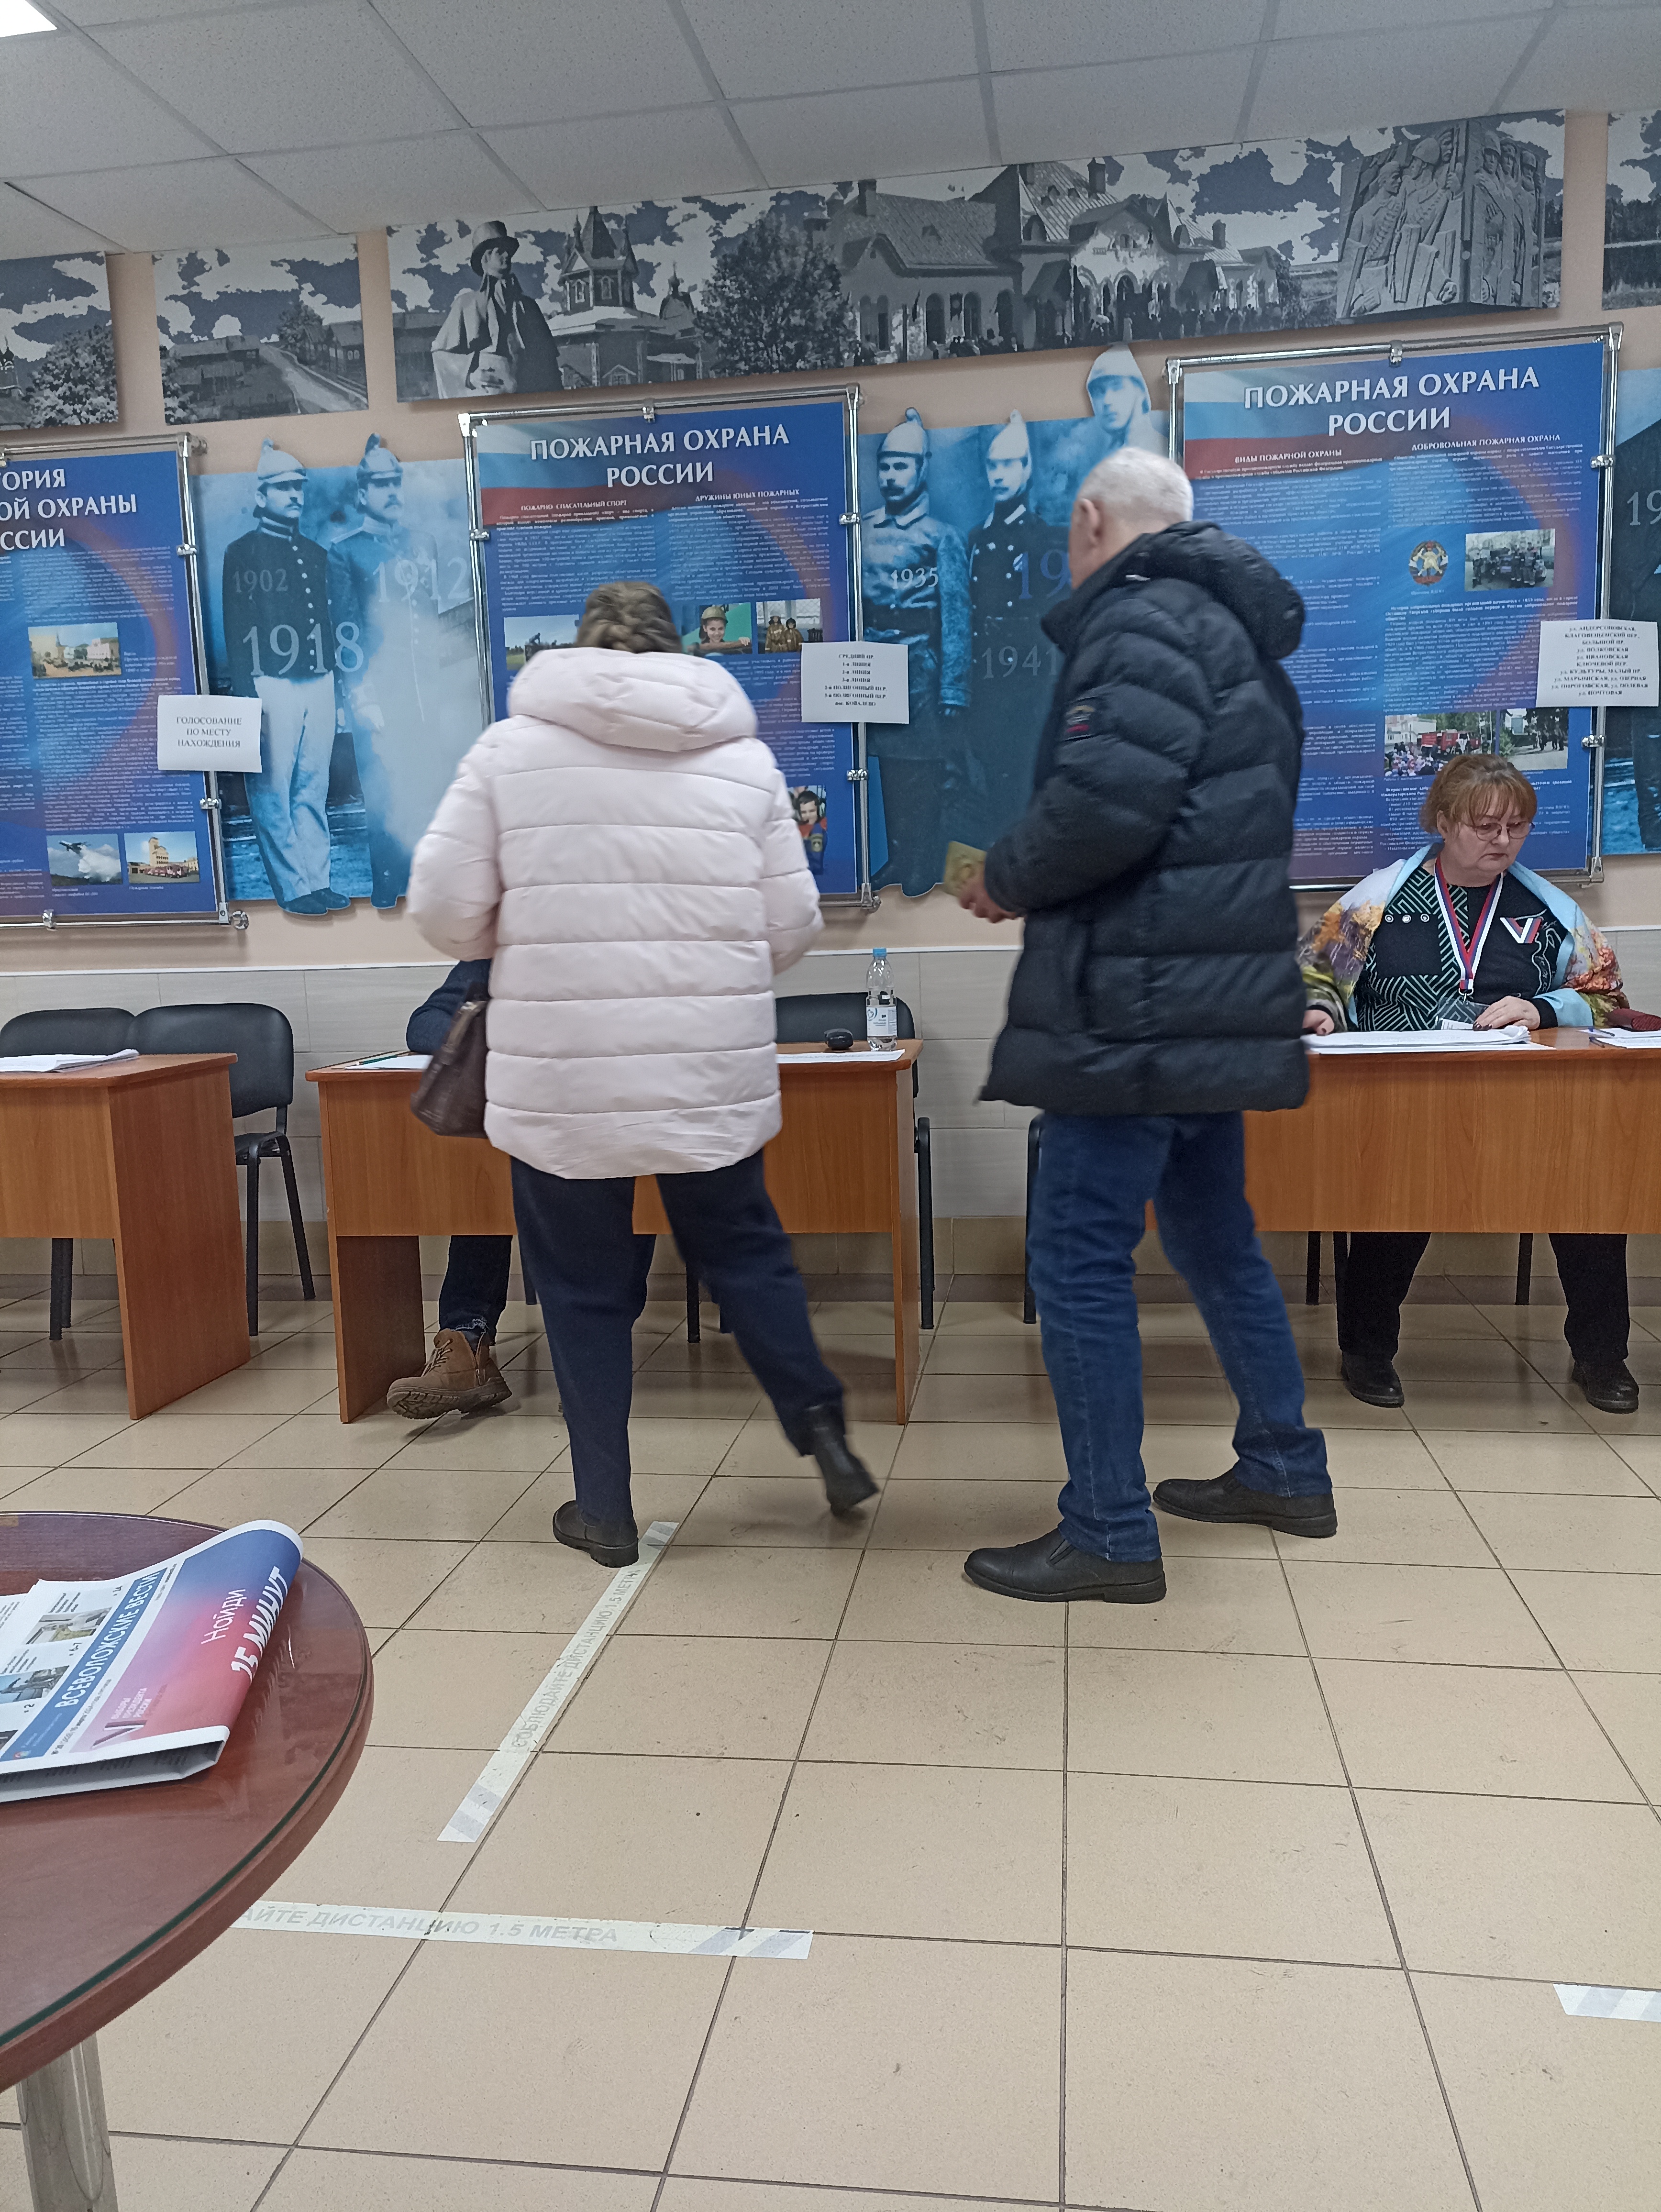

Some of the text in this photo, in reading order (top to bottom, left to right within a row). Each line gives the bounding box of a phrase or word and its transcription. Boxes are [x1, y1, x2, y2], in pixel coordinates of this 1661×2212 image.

[1244, 366, 1539, 409] ПОЖАРНАЯ ОХРАНА
[1329, 407, 1451, 436] РОССИИ
[530, 424, 789, 460] ПОЖАРНАЯ ОХРАНА
[1259, 451, 1307, 461] ПОЖАРНОЙ
[1308, 449, 1342, 458] ОХРАНЫ
[1412, 434, 1560, 451] ДОБРОВОЛЬНАЯ ПОЖАРНАЯ ОХРАНА
[0, 468, 66, 491] ОРИЯ
[607, 462, 714, 487] РОССИИ
[38, 494, 137, 518] ОХРАНЫ
[758, 489, 799, 498] ПОЖАРНЫХ
[233, 568, 288, 593] 1902
[373, 557, 470, 603] 1912
[890, 567, 939, 590] 1935
[243, 621, 364, 676] 1918
[176, 716, 242, 725] ГОЛОСОВАНИЕ
[177, 739, 241, 748] НАХОЖДЕНИЯ
[201, 1589, 247, 1645] Найди
[243, 1566, 288, 1660] МИНУТ
[55, 1608, 140, 1708] ВСЕВОЛОЖСКИЕ
[124, 1571, 160, 1610] ВЕСТИ
[511, 1671, 573, 1748] СОБЛЮДАЙТЕ
[564, 1611, 613, 1670] ДИСТАНЦИЮ
[306, 1911, 480, 1936] ДИСТАНЦИЮ
[489, 1923, 524, 1936] 1.5
[529, 1924, 618, 1942] МЕТРА
